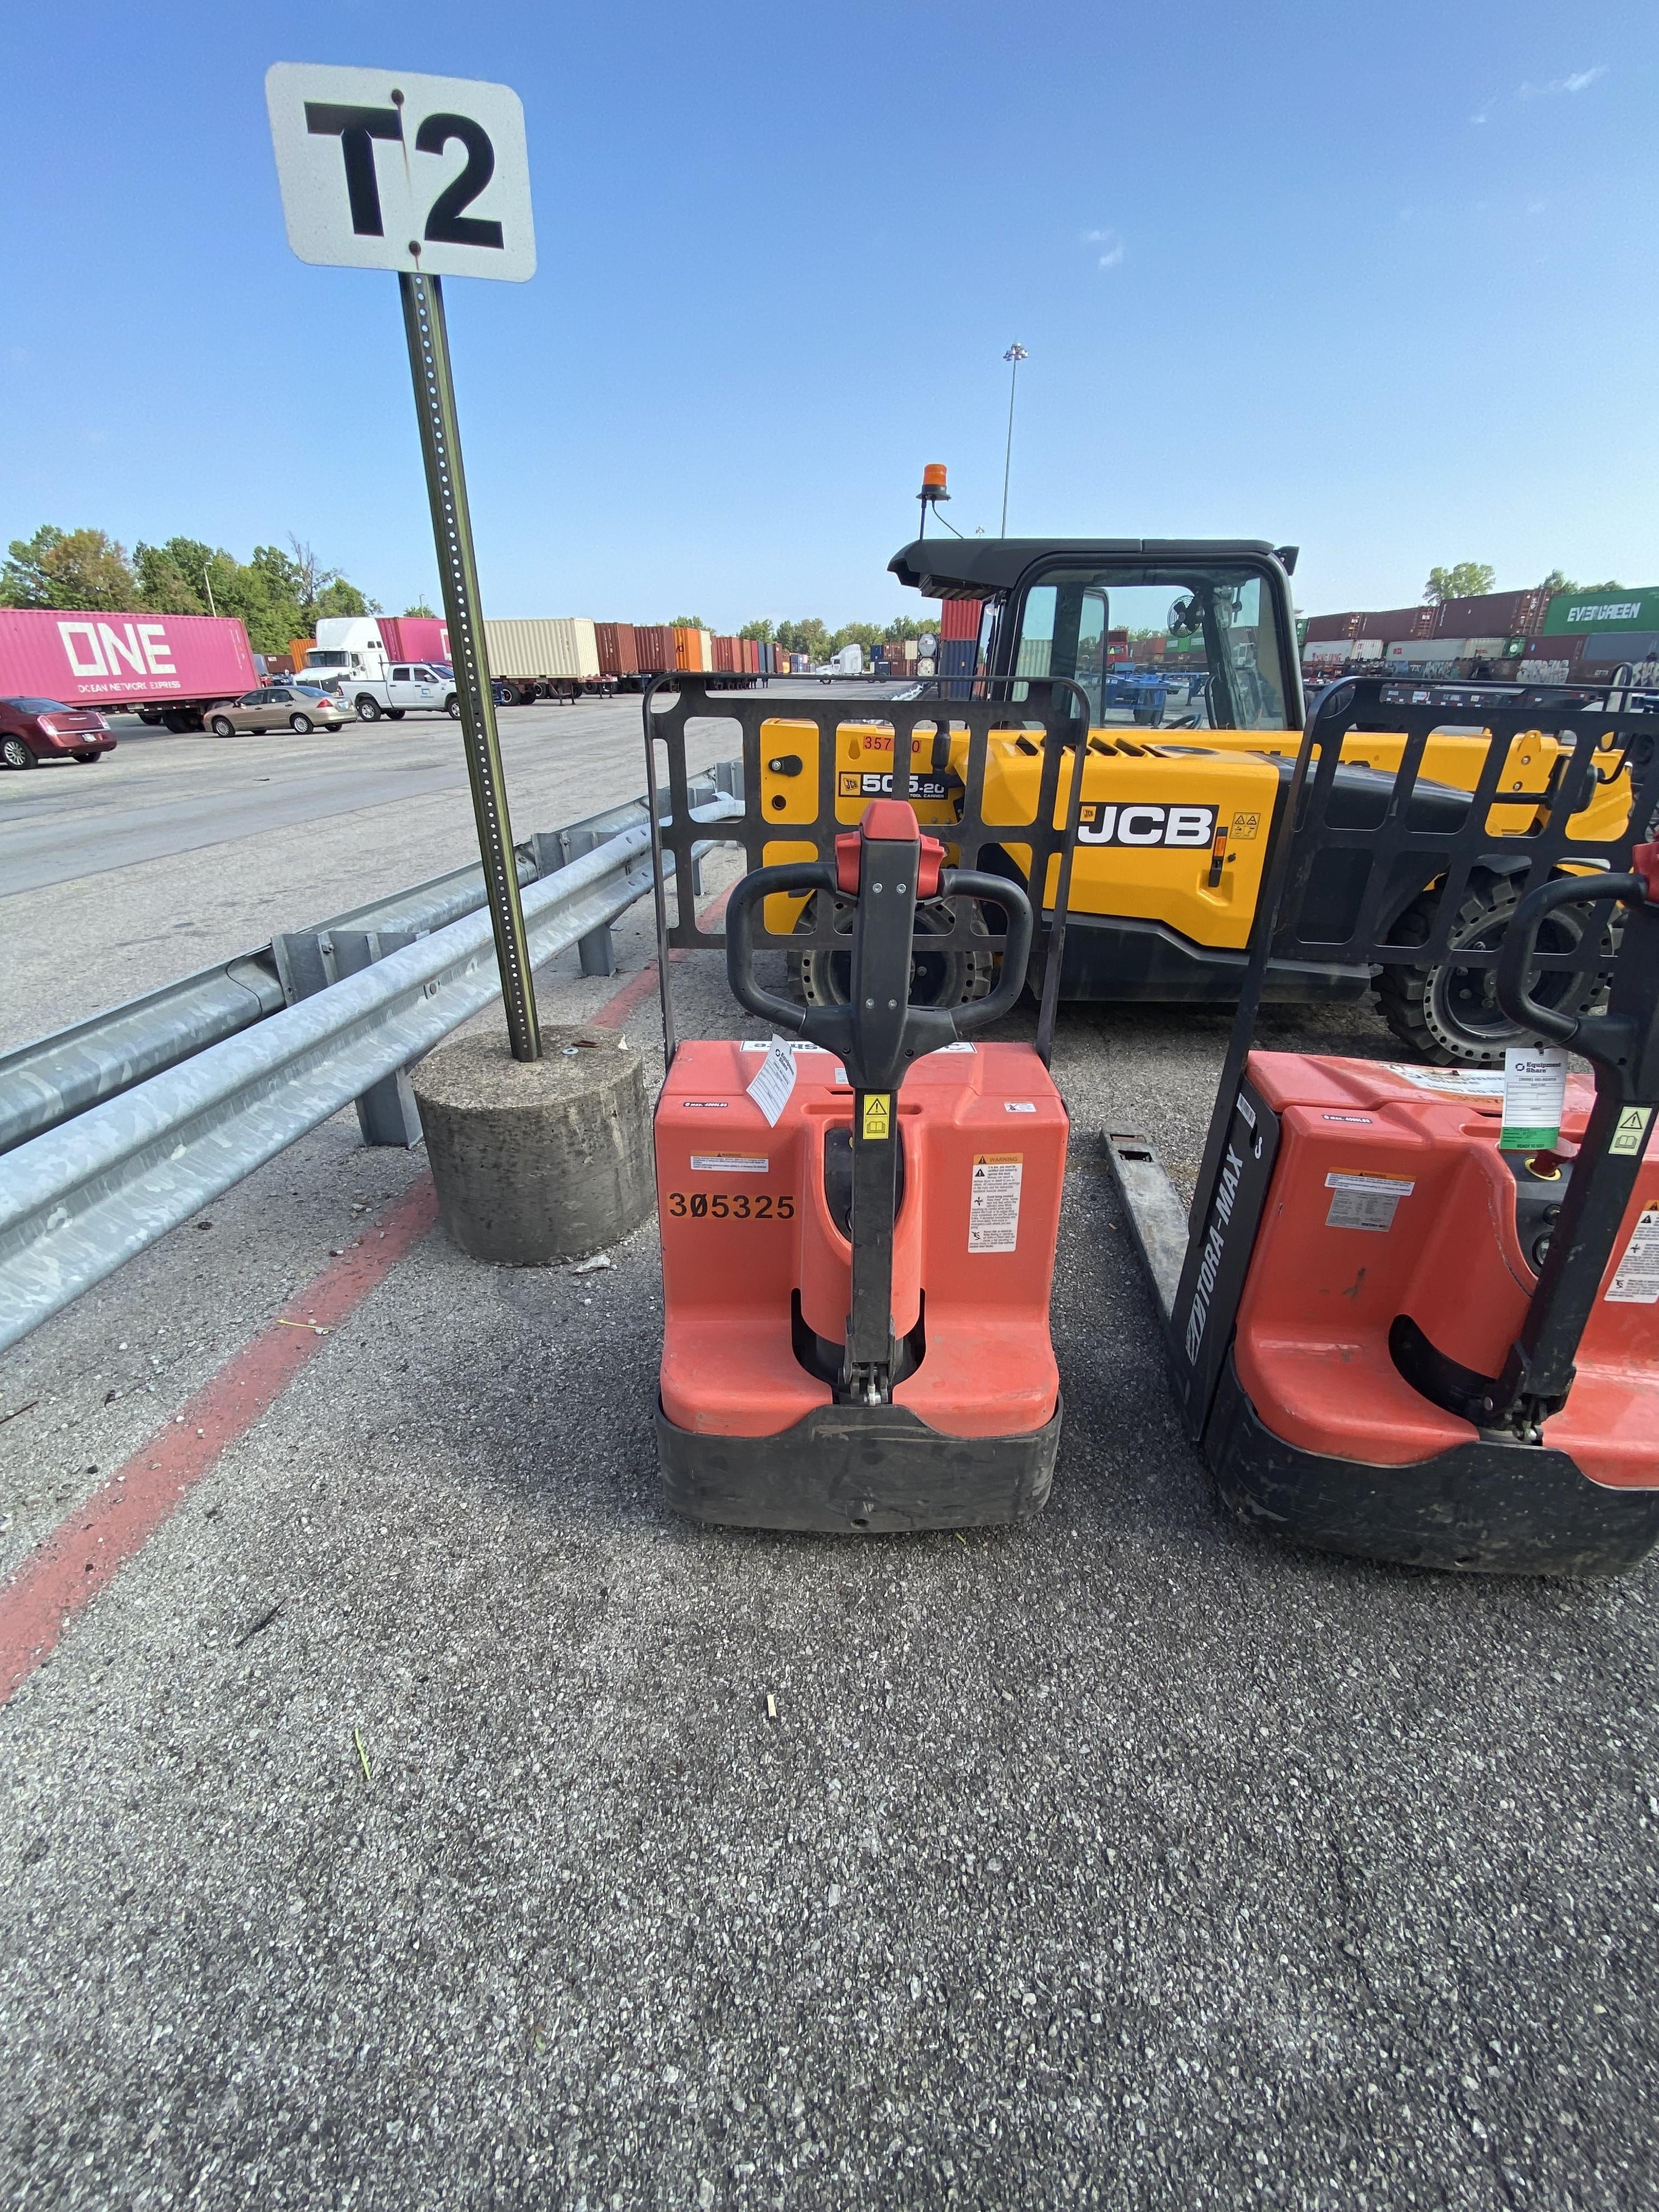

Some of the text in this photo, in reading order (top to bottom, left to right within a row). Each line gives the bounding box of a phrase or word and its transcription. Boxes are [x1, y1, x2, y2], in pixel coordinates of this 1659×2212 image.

[303, 101, 504, 250] T2
[1567, 602, 1641, 622] EVERGREEN
[57, 621, 177, 676] ONE
[78, 681, 181, 693] OCEAN NETWORK EXPRESS
[864, 736, 920, 753] 3570
[1077, 806, 1213, 845] JCB
[1196, 1143, 1244, 1306] TORA-MAX
